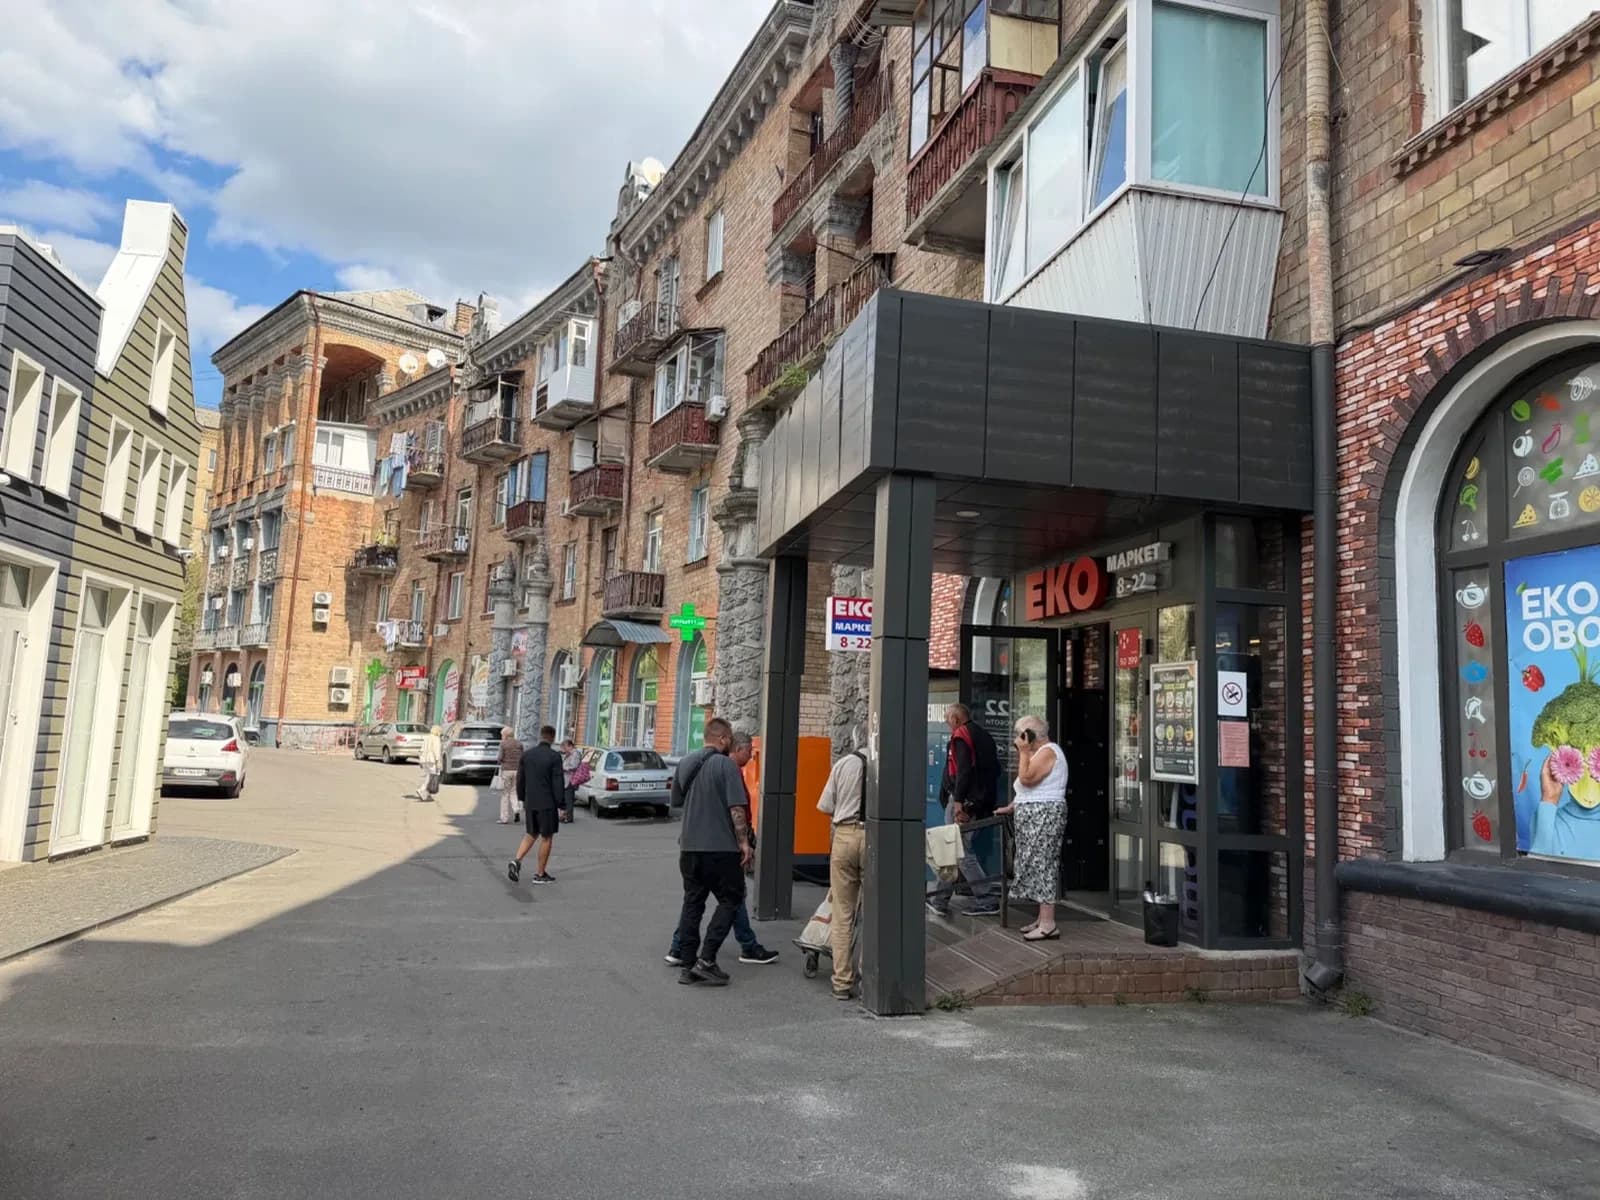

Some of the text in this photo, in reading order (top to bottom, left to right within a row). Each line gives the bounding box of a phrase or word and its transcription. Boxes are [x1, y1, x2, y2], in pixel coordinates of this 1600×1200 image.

[1106, 541, 1165, 573] МАРКЕТ
[1025, 556, 1101, 622] ЕКО
[1116, 571, 1150, 597] 8-22
[1521, 581, 1599, 620] ЕКО
[1522, 616, 1600, 652] ОВО
